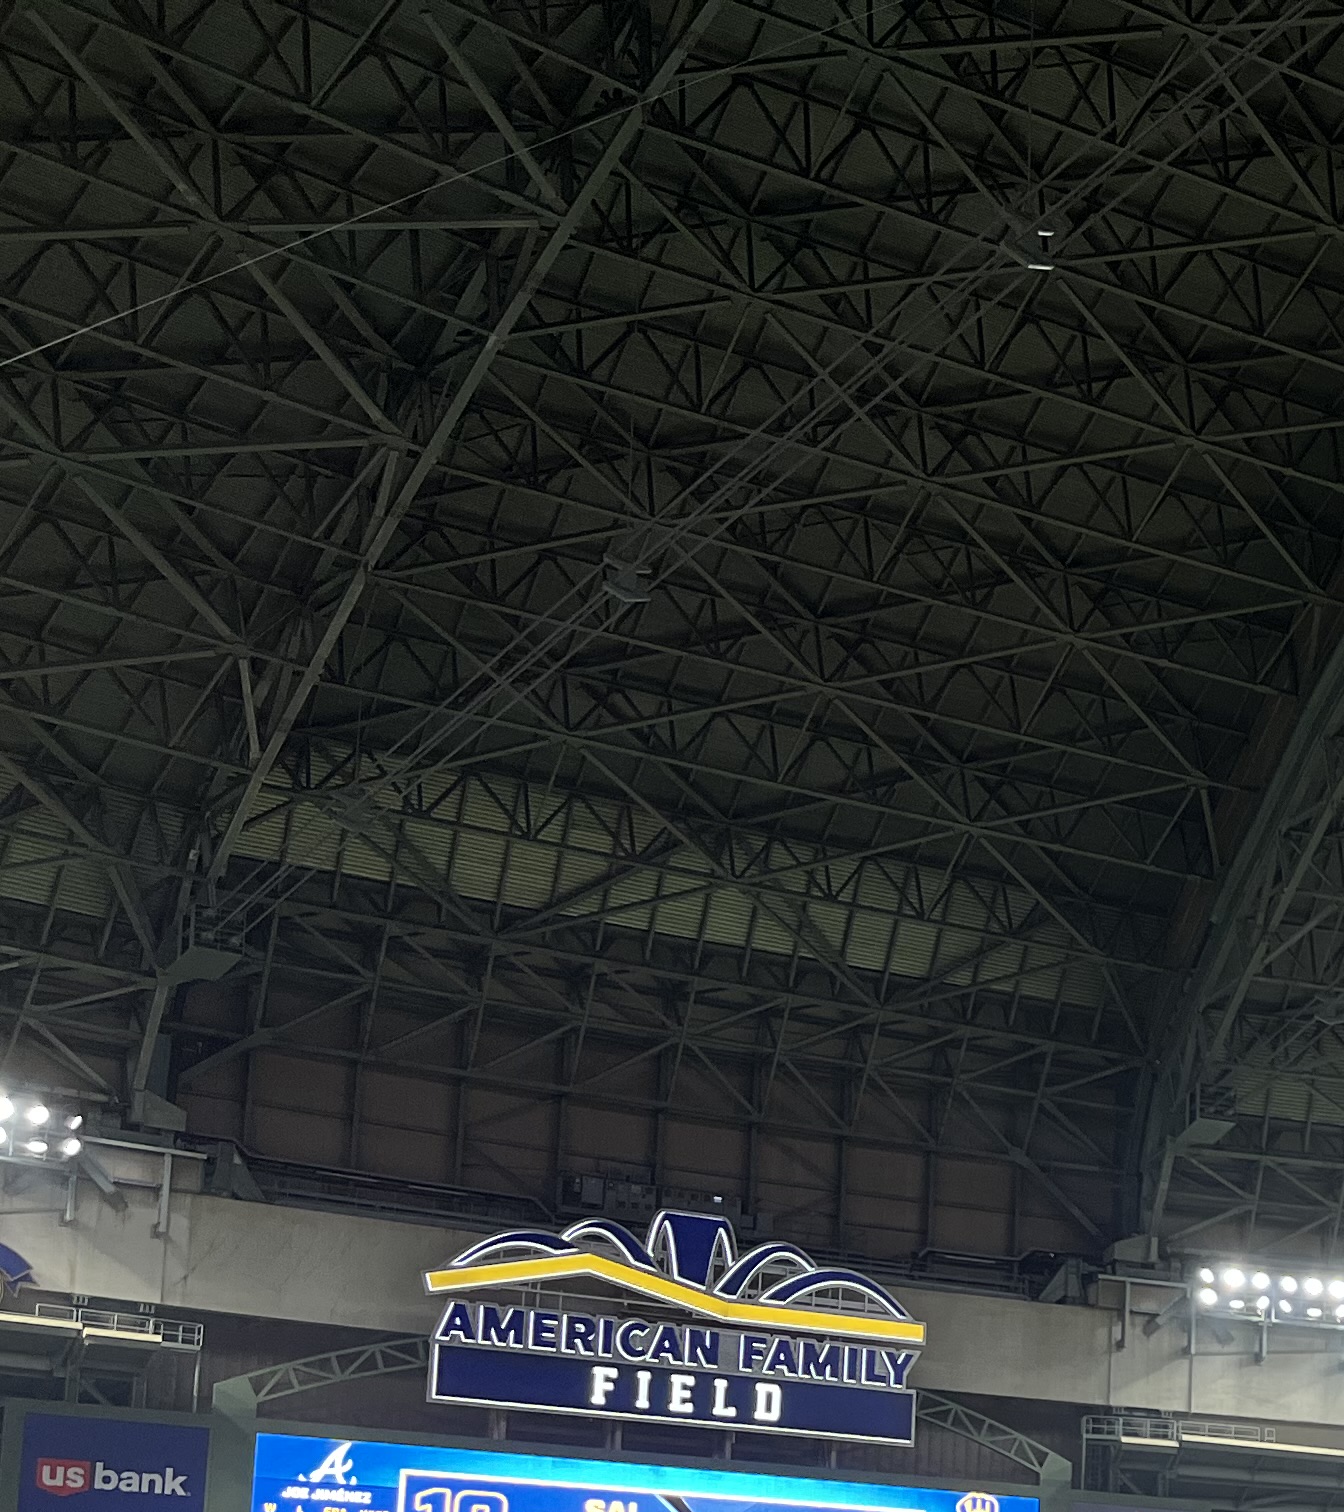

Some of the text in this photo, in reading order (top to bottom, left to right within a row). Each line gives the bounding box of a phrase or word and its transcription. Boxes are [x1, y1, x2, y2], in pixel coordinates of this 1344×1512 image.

[436, 1301, 915, 1389] AMERICAN FAMILY
[591, 1366, 782, 1421] FIELD
